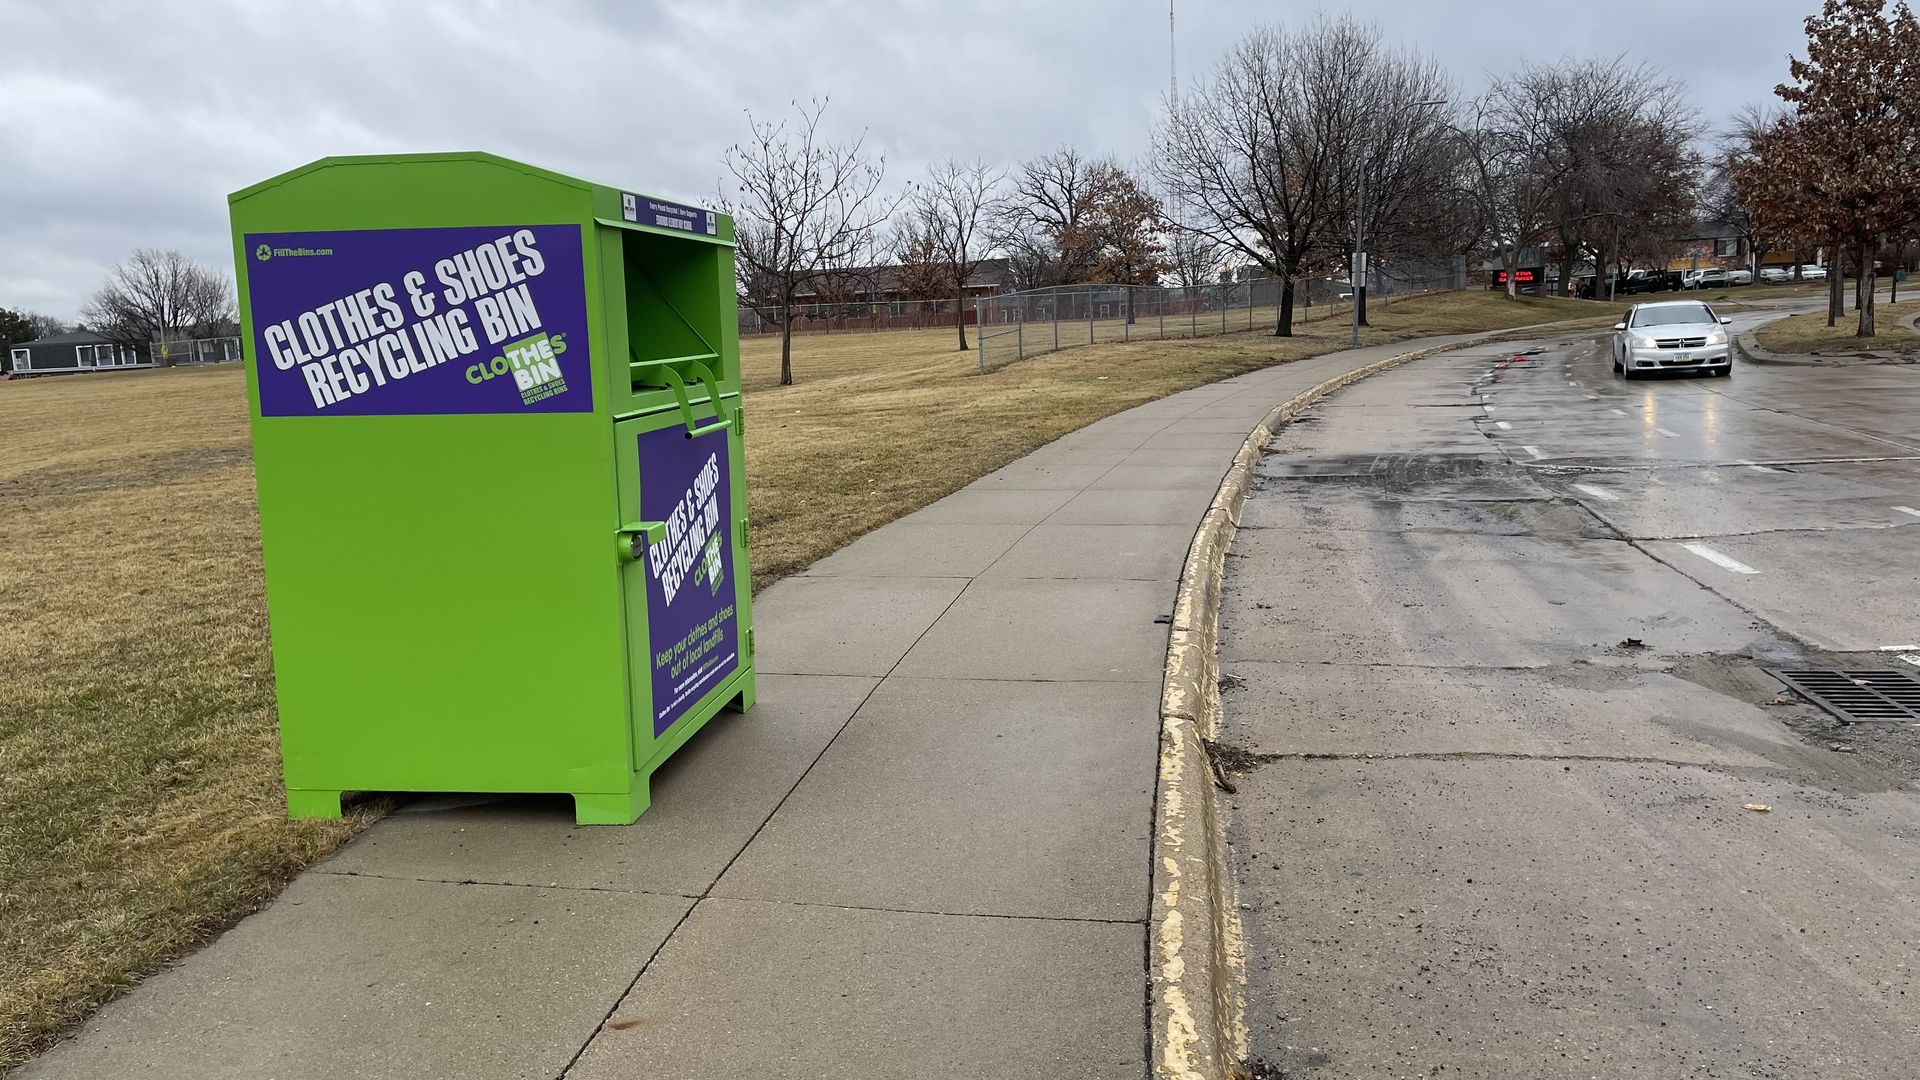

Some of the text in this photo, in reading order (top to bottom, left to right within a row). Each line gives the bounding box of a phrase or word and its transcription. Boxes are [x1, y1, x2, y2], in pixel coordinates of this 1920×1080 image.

[273, 248, 333, 257] FillTheBins.com
[263, 229, 545, 371] CLOTHES & SHOES
[301, 283, 543, 409] RECYCLING BIN
[514, 358, 561, 390] BIN
[520, 386, 544, 399] CLOTHES
[548, 378, 566, 390] SHOES
[523, 385, 568, 406] RECYCLING BINS
[649, 452, 720, 580] CLOTHES & SHOES
[660, 516, 706, 608] RECYCLING
[704, 492, 720, 535] BIN
[708, 552, 722, 585] BIN
[656, 604, 734, 670] Keep your clothes and shoes
[671, 661, 682, 679] out
[682, 655, 689, 670] of
[689, 642, 702, 666] local
[703, 629, 724, 656] landfills
